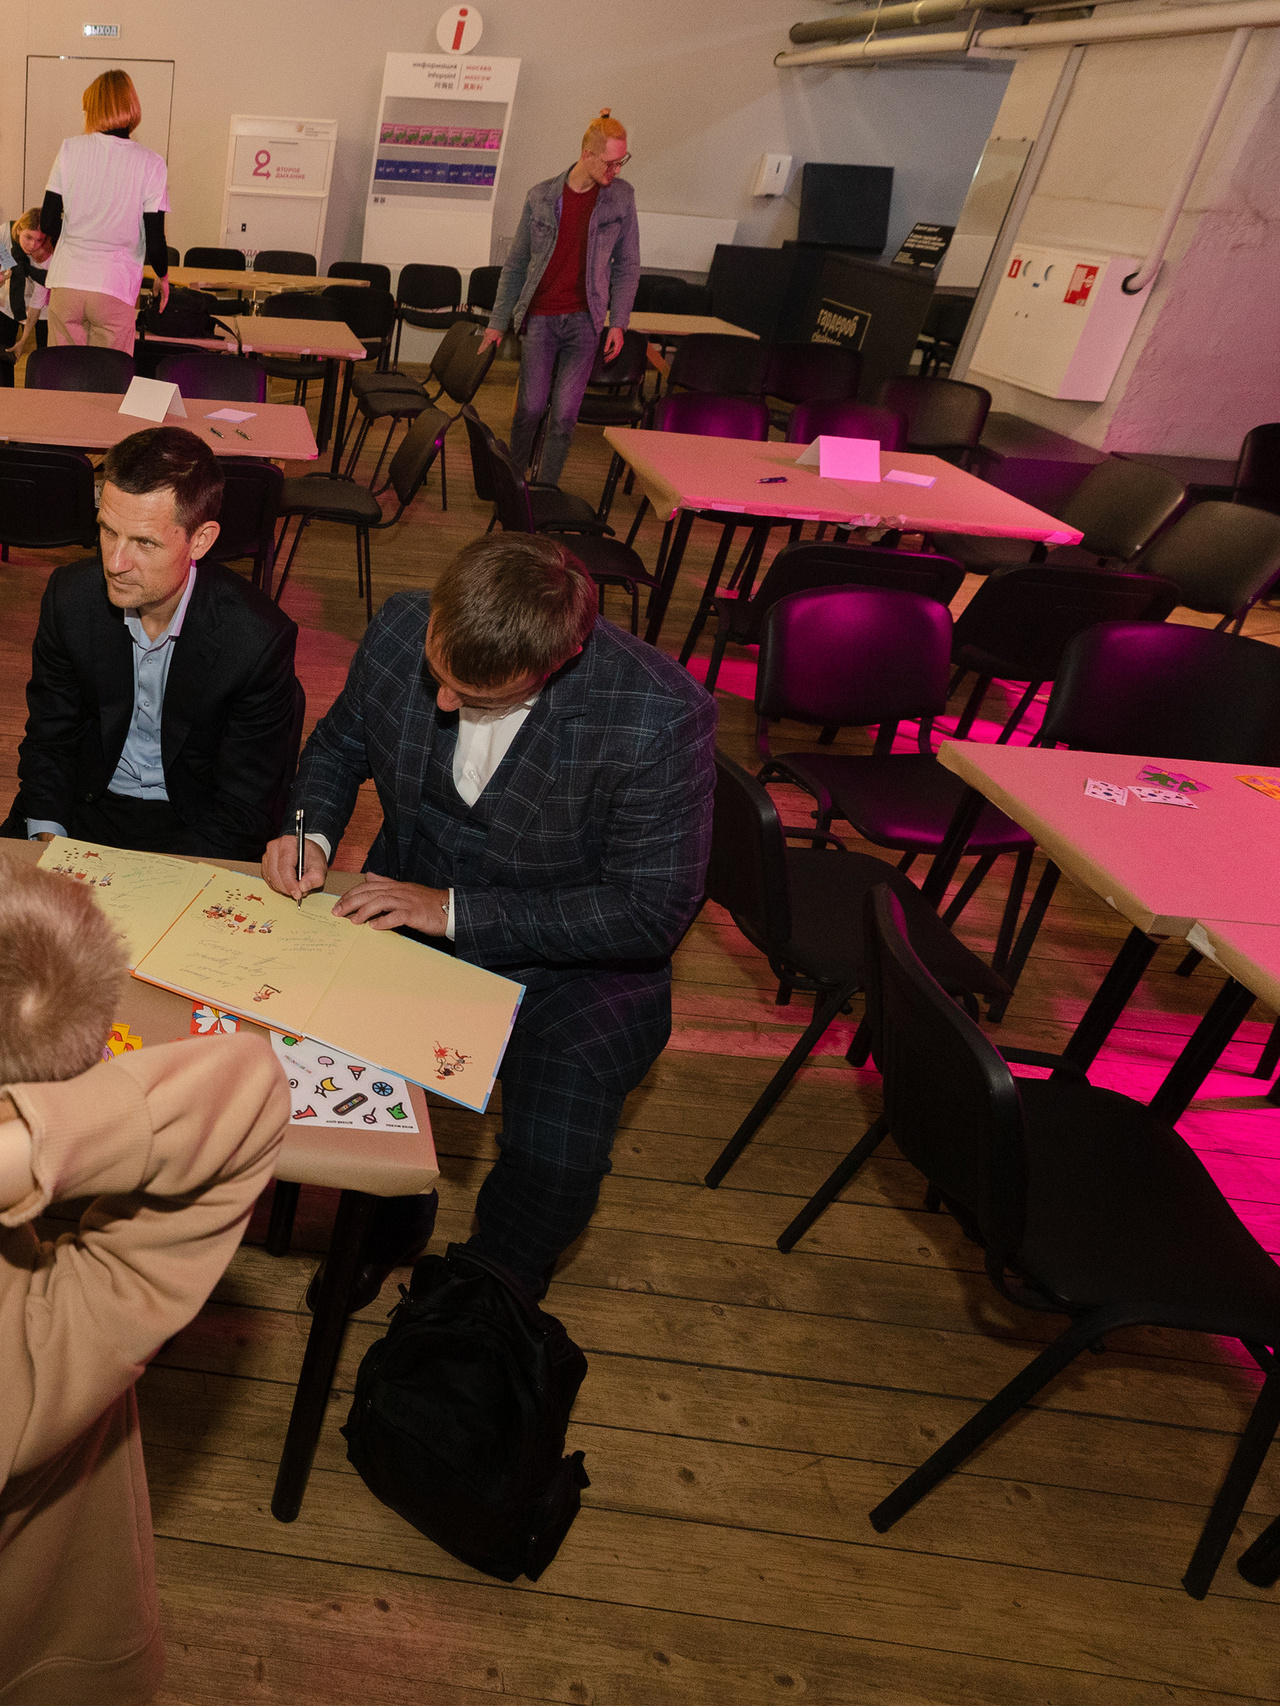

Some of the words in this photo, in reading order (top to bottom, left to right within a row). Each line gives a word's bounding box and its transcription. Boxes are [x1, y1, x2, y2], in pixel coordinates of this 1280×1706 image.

[85, 25, 117, 36] ЫХОД
[452, 8, 468, 50] i
[817, 309, 859, 338] гардероб
